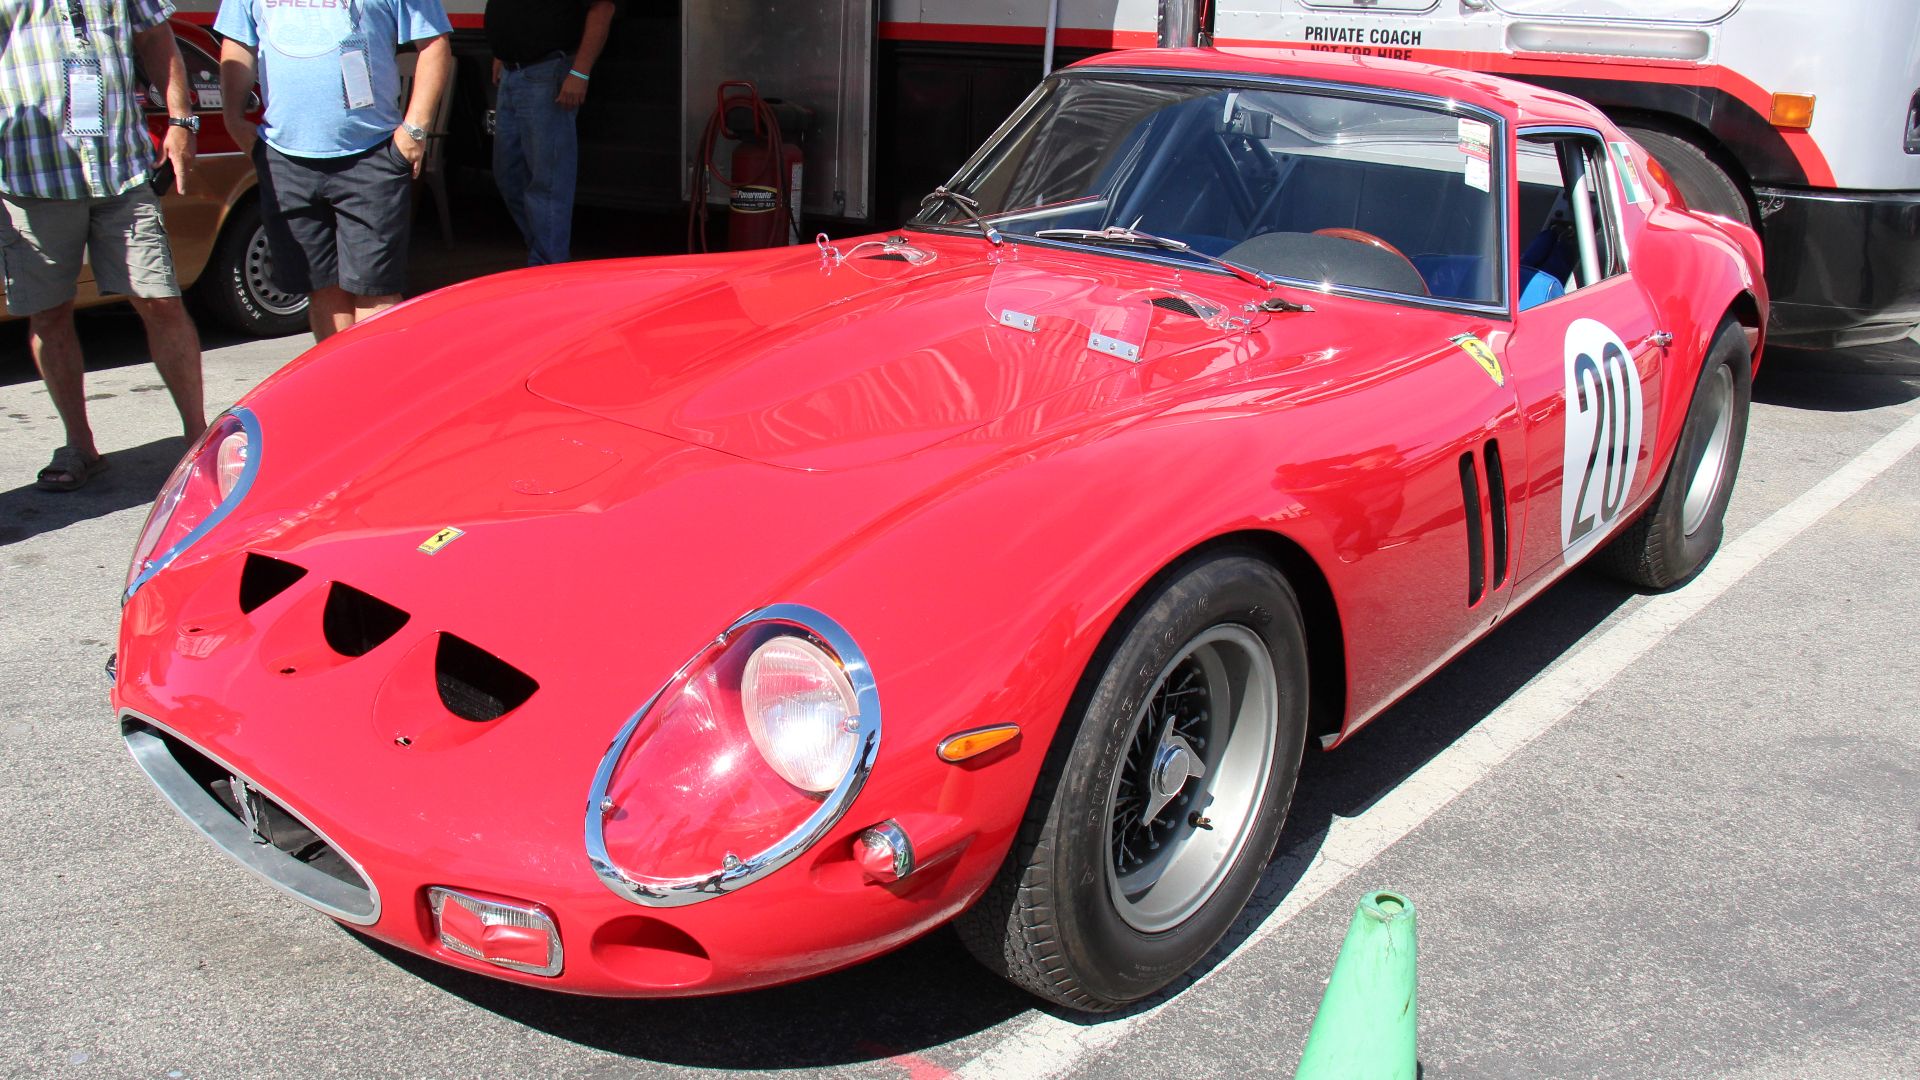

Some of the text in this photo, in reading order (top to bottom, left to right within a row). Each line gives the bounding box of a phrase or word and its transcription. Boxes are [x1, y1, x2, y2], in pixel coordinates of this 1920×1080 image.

[1304, 26, 1422, 46] PRIVATE COACH
[737, 189, 772, 199] Powermate
[233, 267, 262, 320] HOOSIER
[1568, 341, 1631, 544] 20
